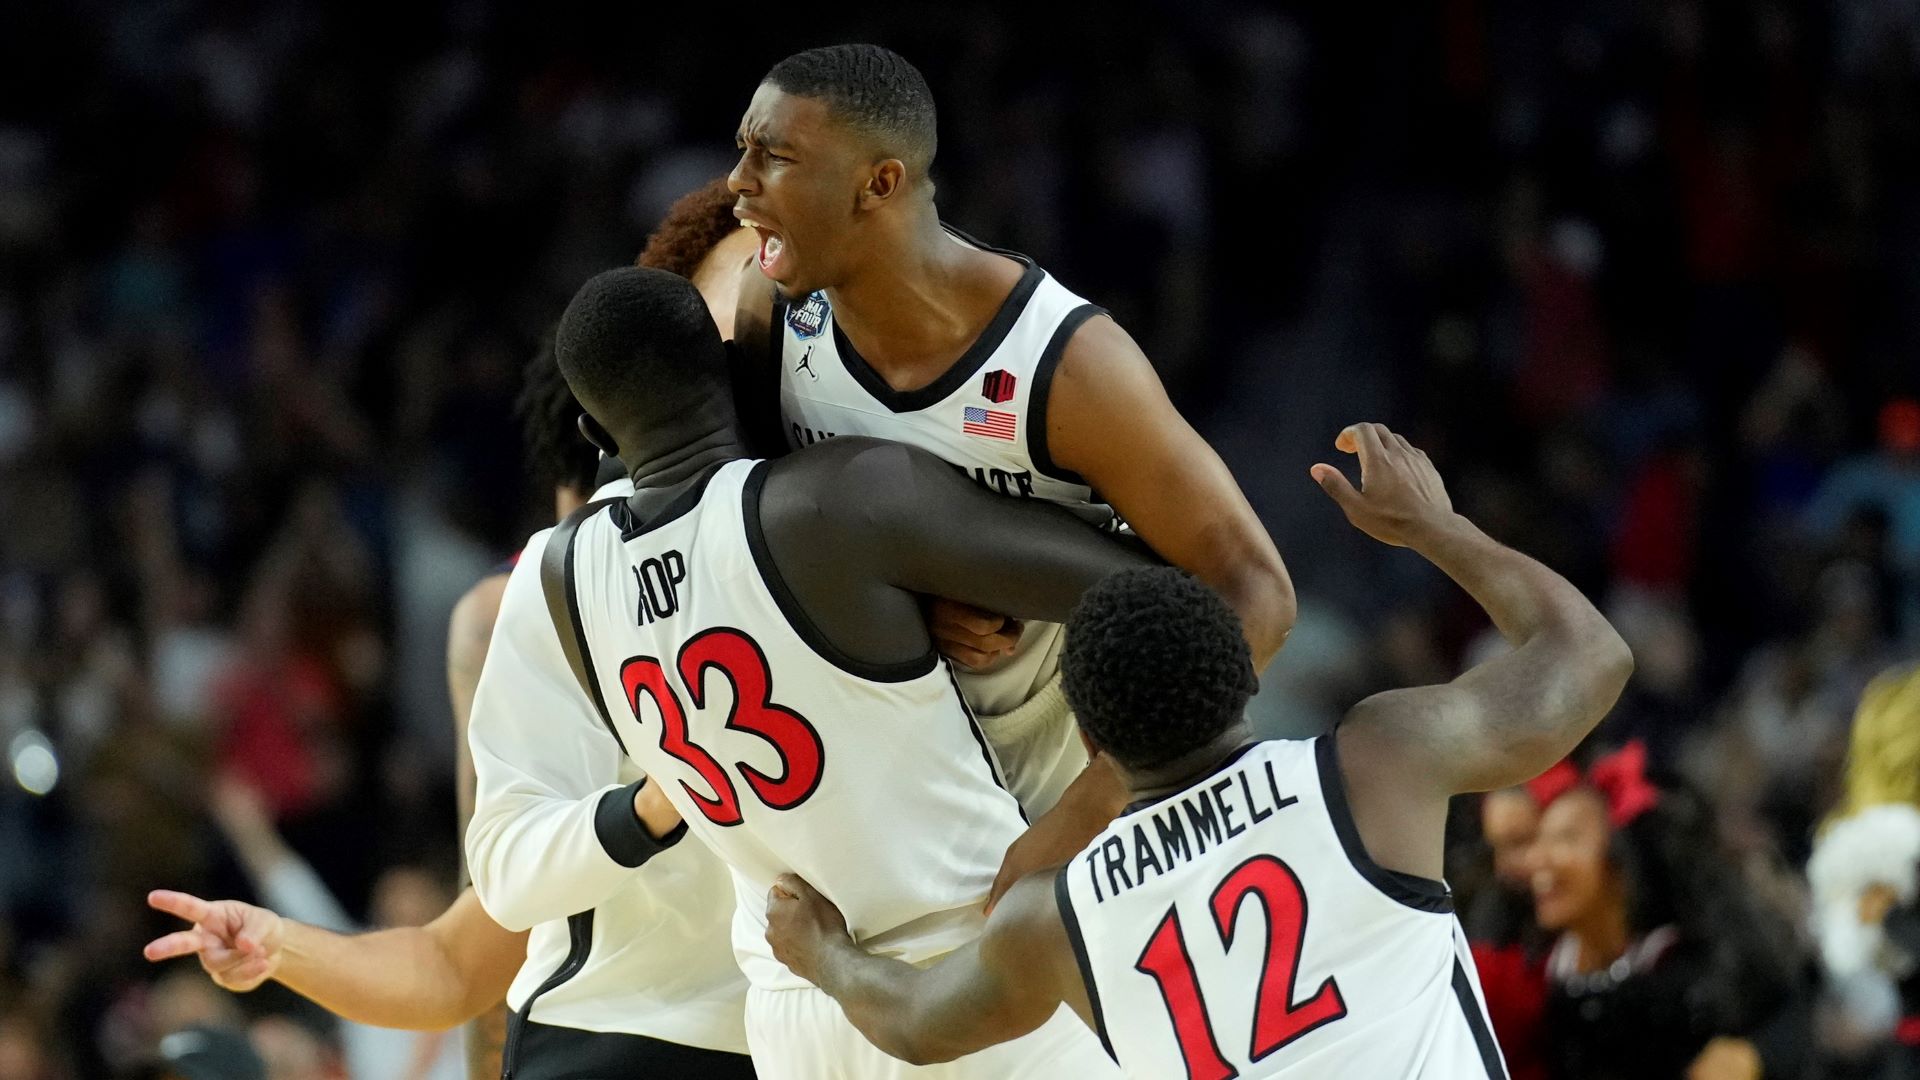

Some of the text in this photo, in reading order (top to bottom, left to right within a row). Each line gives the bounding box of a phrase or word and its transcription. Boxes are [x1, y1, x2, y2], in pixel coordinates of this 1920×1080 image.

[795, 309, 821, 328] FOUR
[802, 299, 824, 317] NAL
[620, 626, 825, 827] 33
[1086, 761, 1299, 904] TRAMMELL
[1134, 854, 1347, 1080] 12
